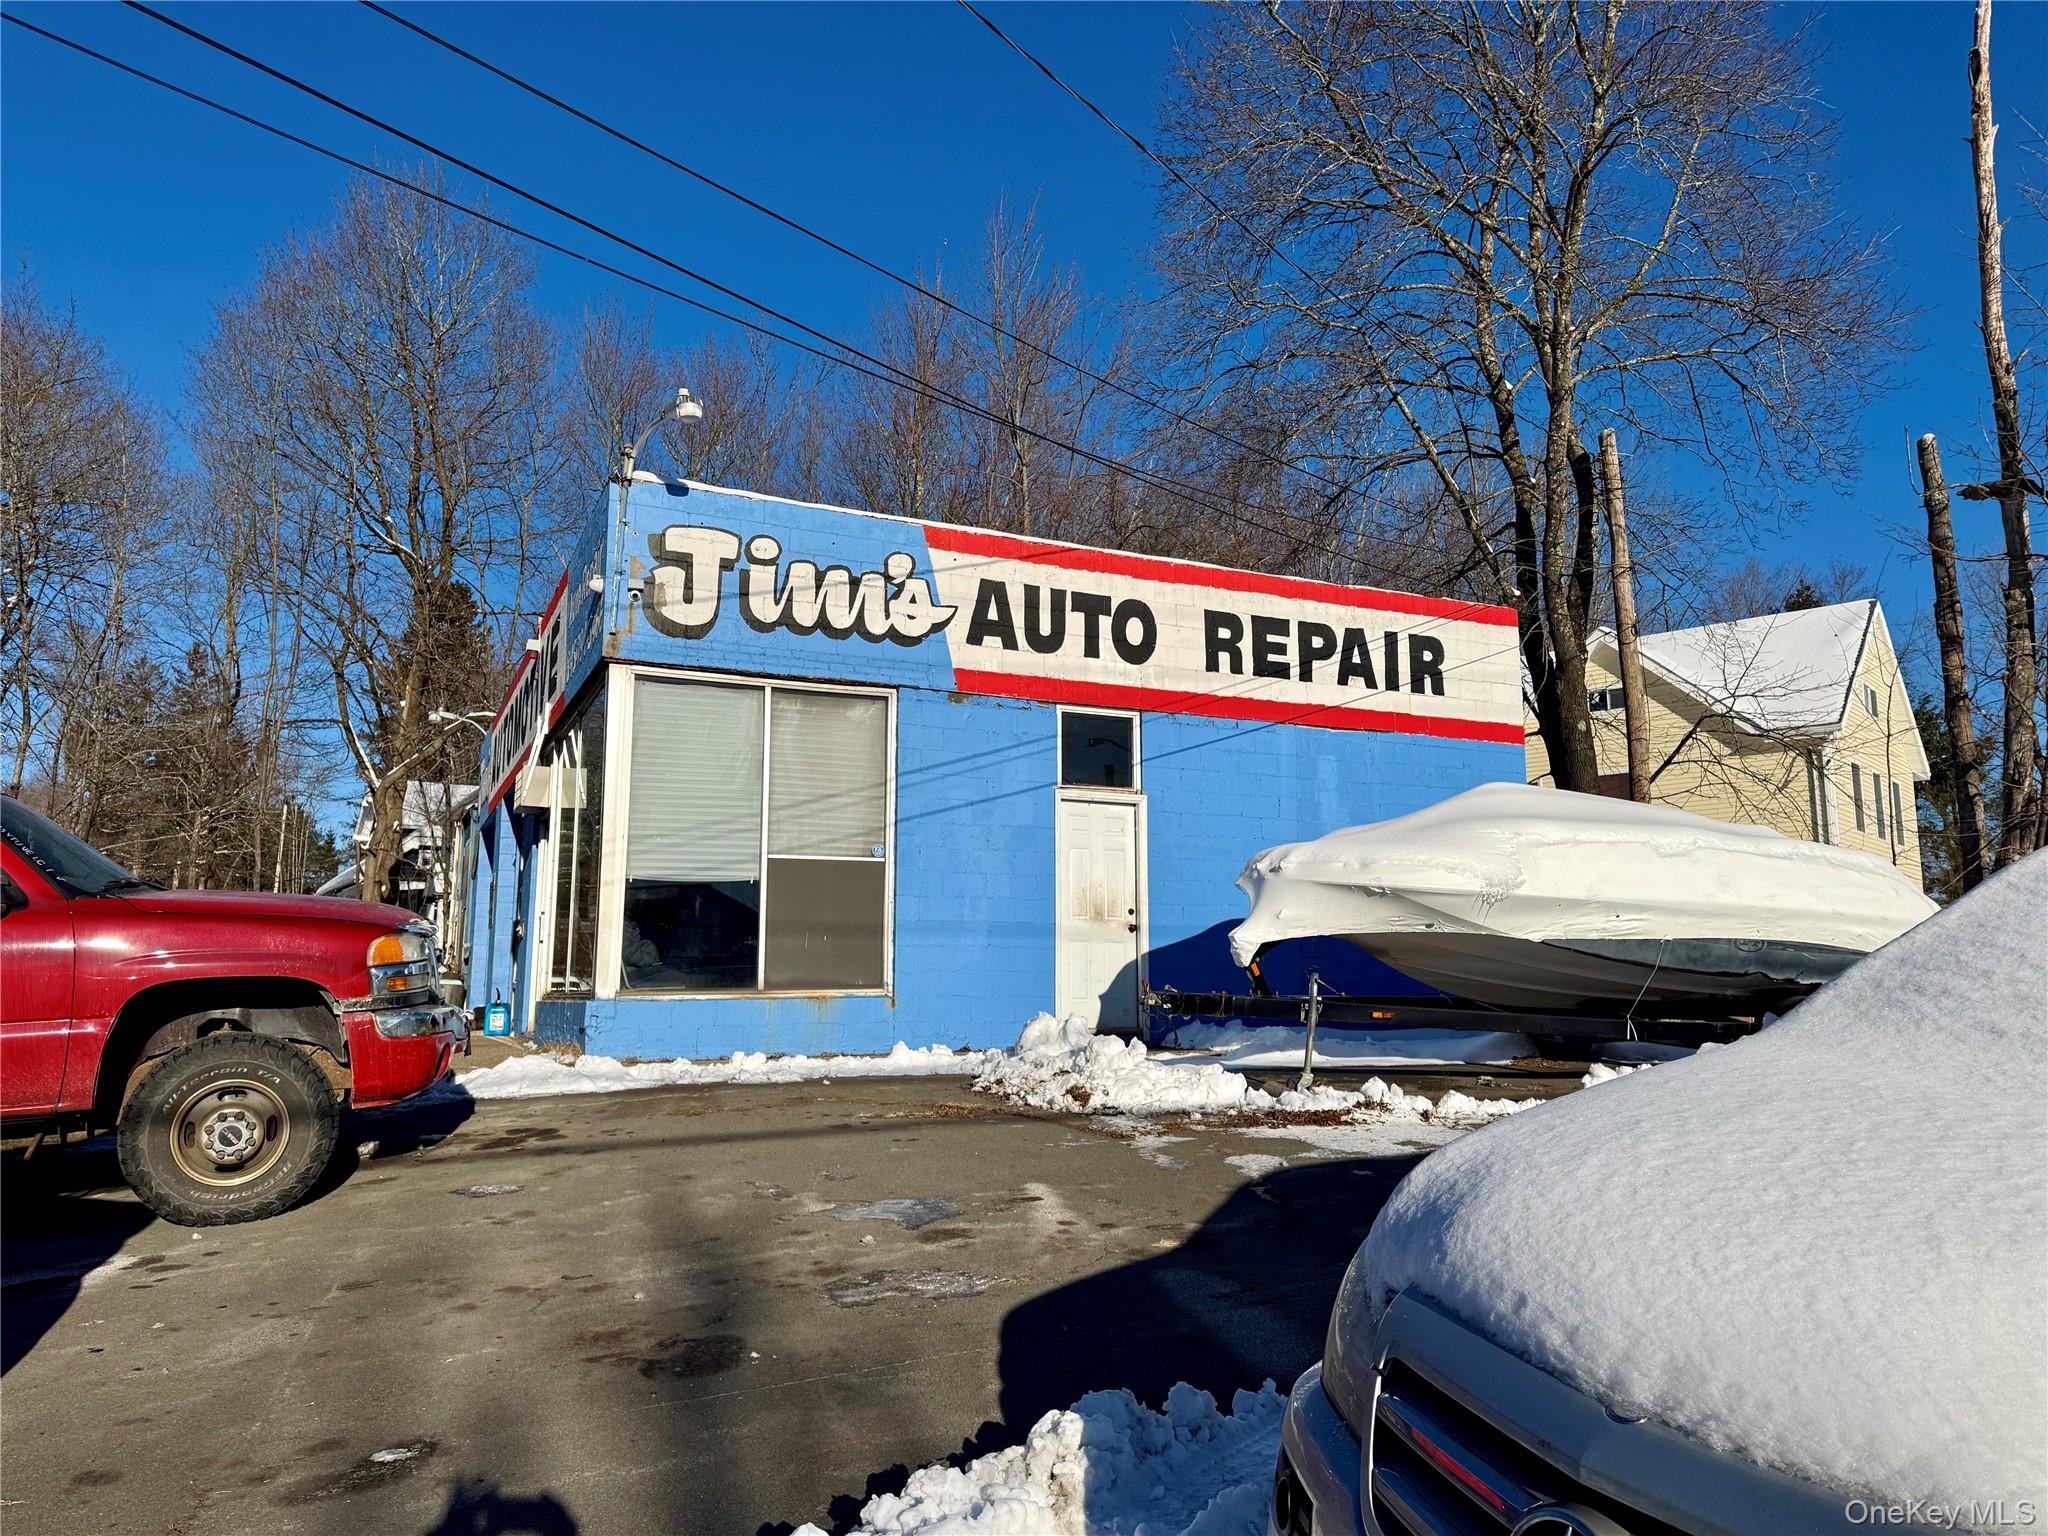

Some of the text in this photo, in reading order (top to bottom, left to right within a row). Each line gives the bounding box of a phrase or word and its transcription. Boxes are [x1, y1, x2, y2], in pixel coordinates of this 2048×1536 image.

[643, 525, 957, 647] Jim's
[966, 578, 1157, 666] AUTO
[1204, 609, 1446, 697] REPAIR
[256, 1069, 281, 1086] T/A
